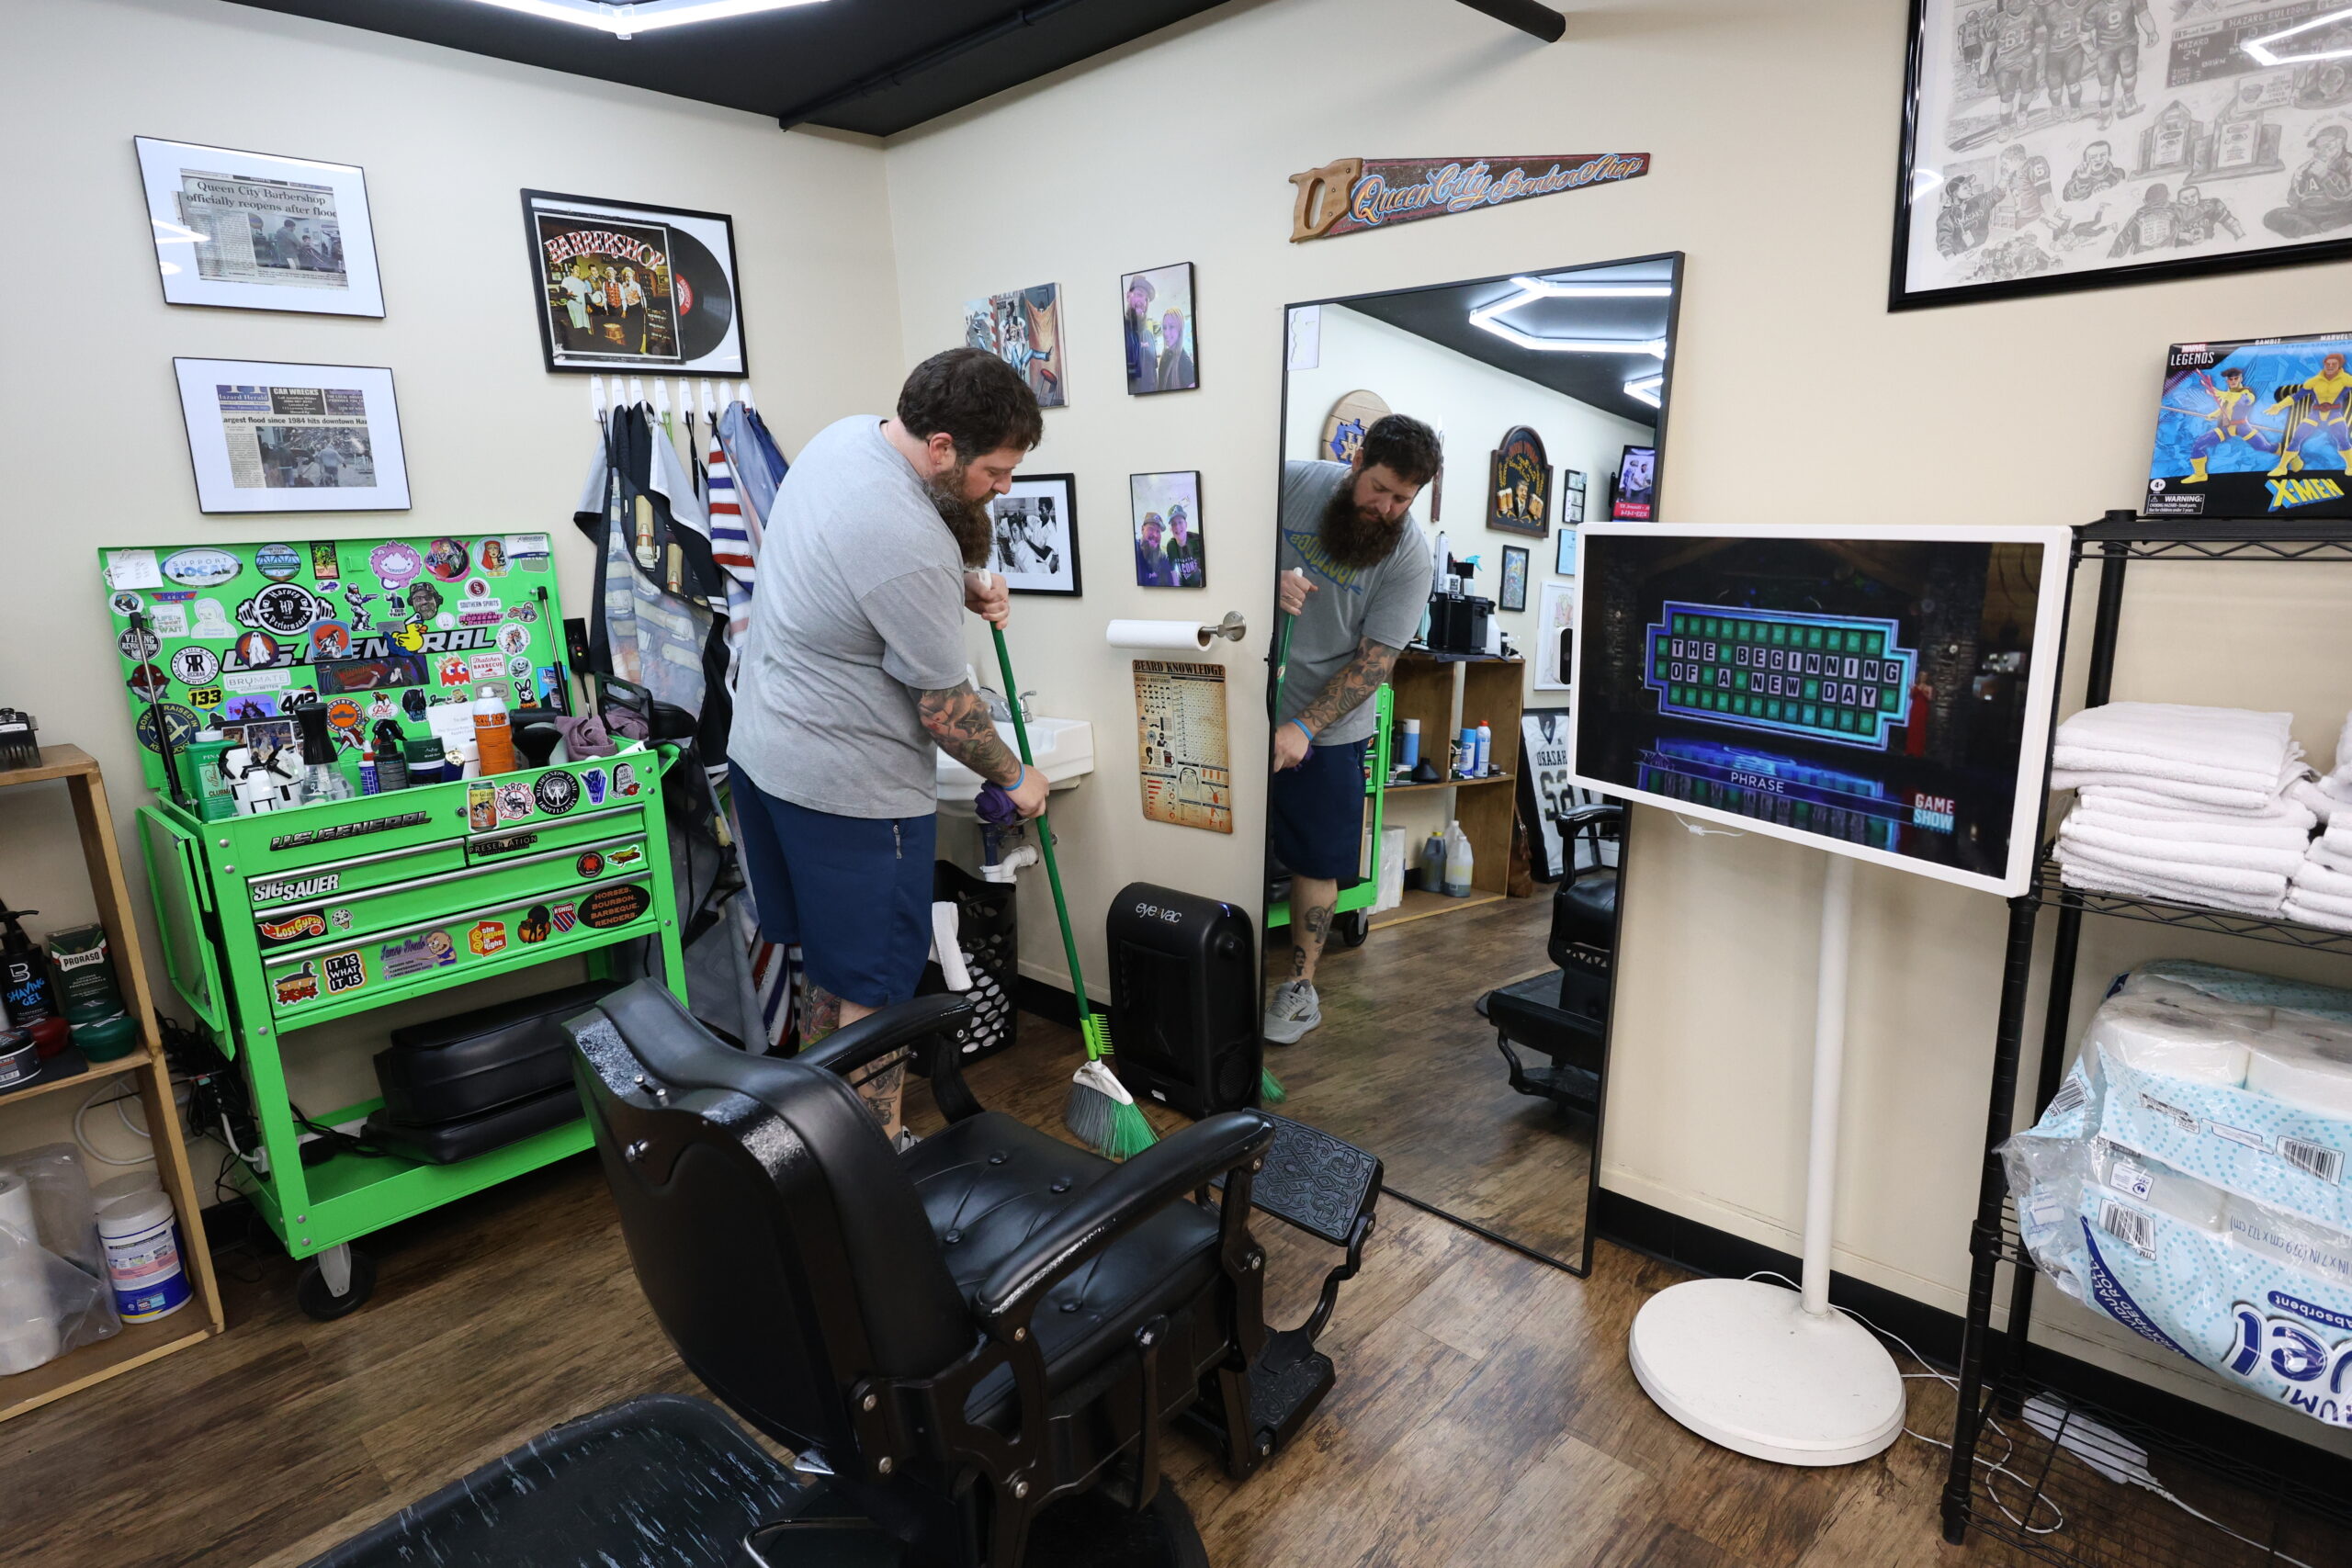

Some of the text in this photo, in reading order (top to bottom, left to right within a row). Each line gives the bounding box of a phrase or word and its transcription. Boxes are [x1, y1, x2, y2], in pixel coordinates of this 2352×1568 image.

[198, 181, 326, 206] Queen City Barbershop
[1350, 153, 1643, 223] Queen City Barber Shop
[187, 193, 235, 208] officially
[239, 200, 282, 212] reopens
[285, 204, 310, 216] after
[544, 230, 666, 271] BARBERSHOP
[2181, 344, 2206, 353] MARVEL
[2171, 352, 2215, 366] LEGENDS
[2265, 478, 2345, 512] X-MEN
[172, 558, 228, 567] SUPPORT
[174, 564, 228, 578] LOCAL
[267, 588, 301, 599] Harvey
[280, 600, 294, 615] HP
[269, 615, 309, 631] Performance
[473, 661, 503, 670] BARBECUE
[1134, 660, 1224, 676] BEARD KNOWLEDGE
[1674, 640, 1899, 682] THE BEGINNING
[1672, 664, 1875, 706] OF A NEW DAY
[190, 689, 221, 706] 133
[164, 705, 193, 719] RAISED
[537, 771, 565, 796] WILDERNESS
[1731, 773, 1785, 794] PHRASE
[1916, 794, 1954, 814] GAME
[317, 811, 432, 841] GENERAL
[1914, 810, 1954, 830] SHOW
[254, 874, 339, 901] SIG SAUER
[553, 905, 573, 914] K-SWISS
[592, 895, 637, 909] BOURBON.
[590, 903, 639, 919] BARBEQUE.
[63, 952, 100, 967] PRORASO
[328, 955, 357, 970] IT IS
[330, 965, 358, 979] WHAT
[6, 977, 45, 1003] SHAVING
[332, 975, 361, 989] IT IS
[22, 992, 42, 1006] GEL
[2270, 1235, 2284, 1248] cm
[2310, 1249, 2321, 1264] IN
